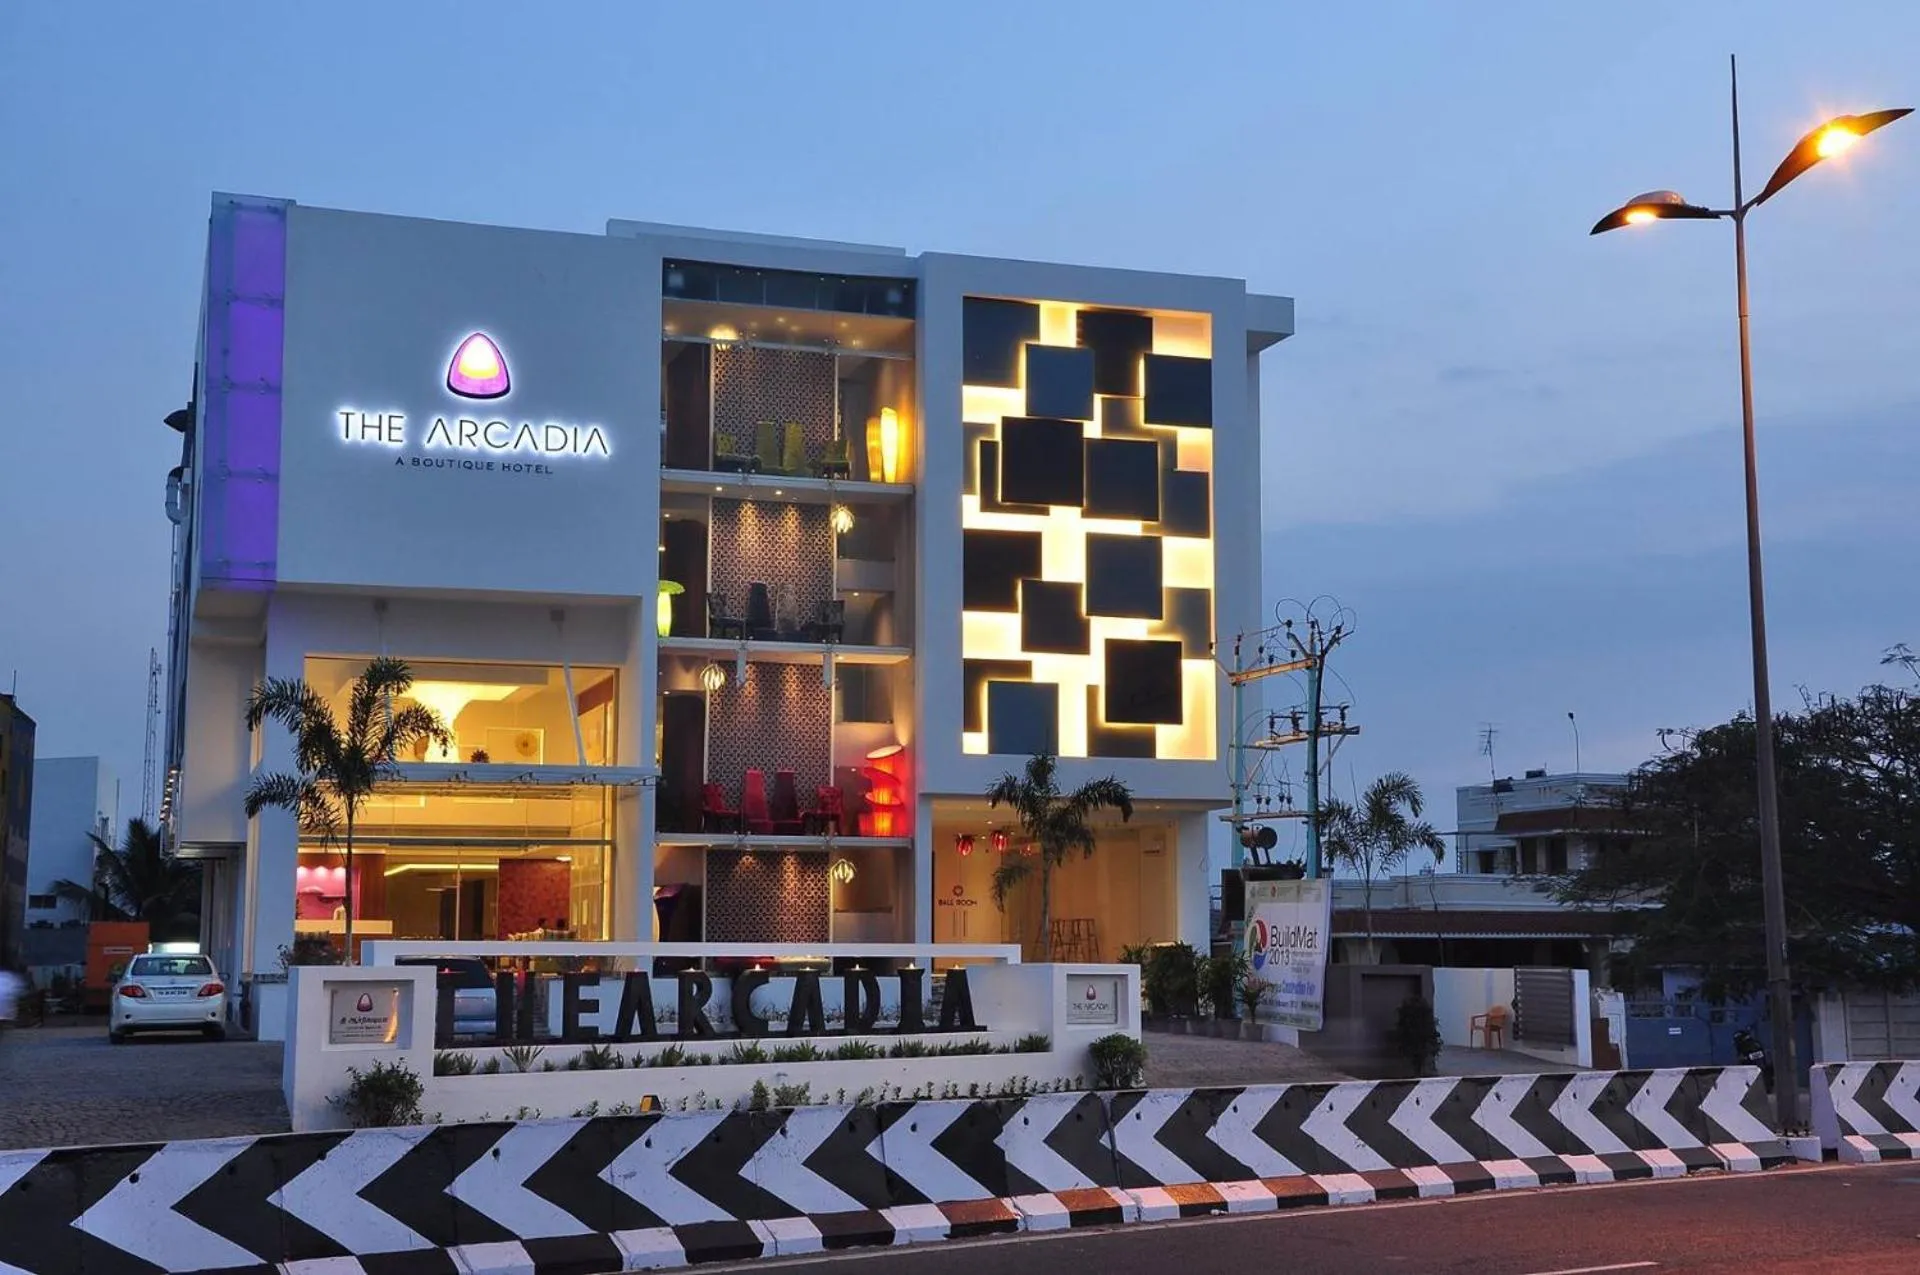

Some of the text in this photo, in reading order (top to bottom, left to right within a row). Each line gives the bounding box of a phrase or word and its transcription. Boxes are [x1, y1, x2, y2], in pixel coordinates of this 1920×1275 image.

[339, 411, 609, 455] THE ARCADIA
[395, 456, 554, 475] A BOUTIQUE HOTEL
[1270, 924, 1318, 949] BuildMat
[1268, 948, 1291, 966] 2013
[614, 966, 978, 1038] ARCADIA
